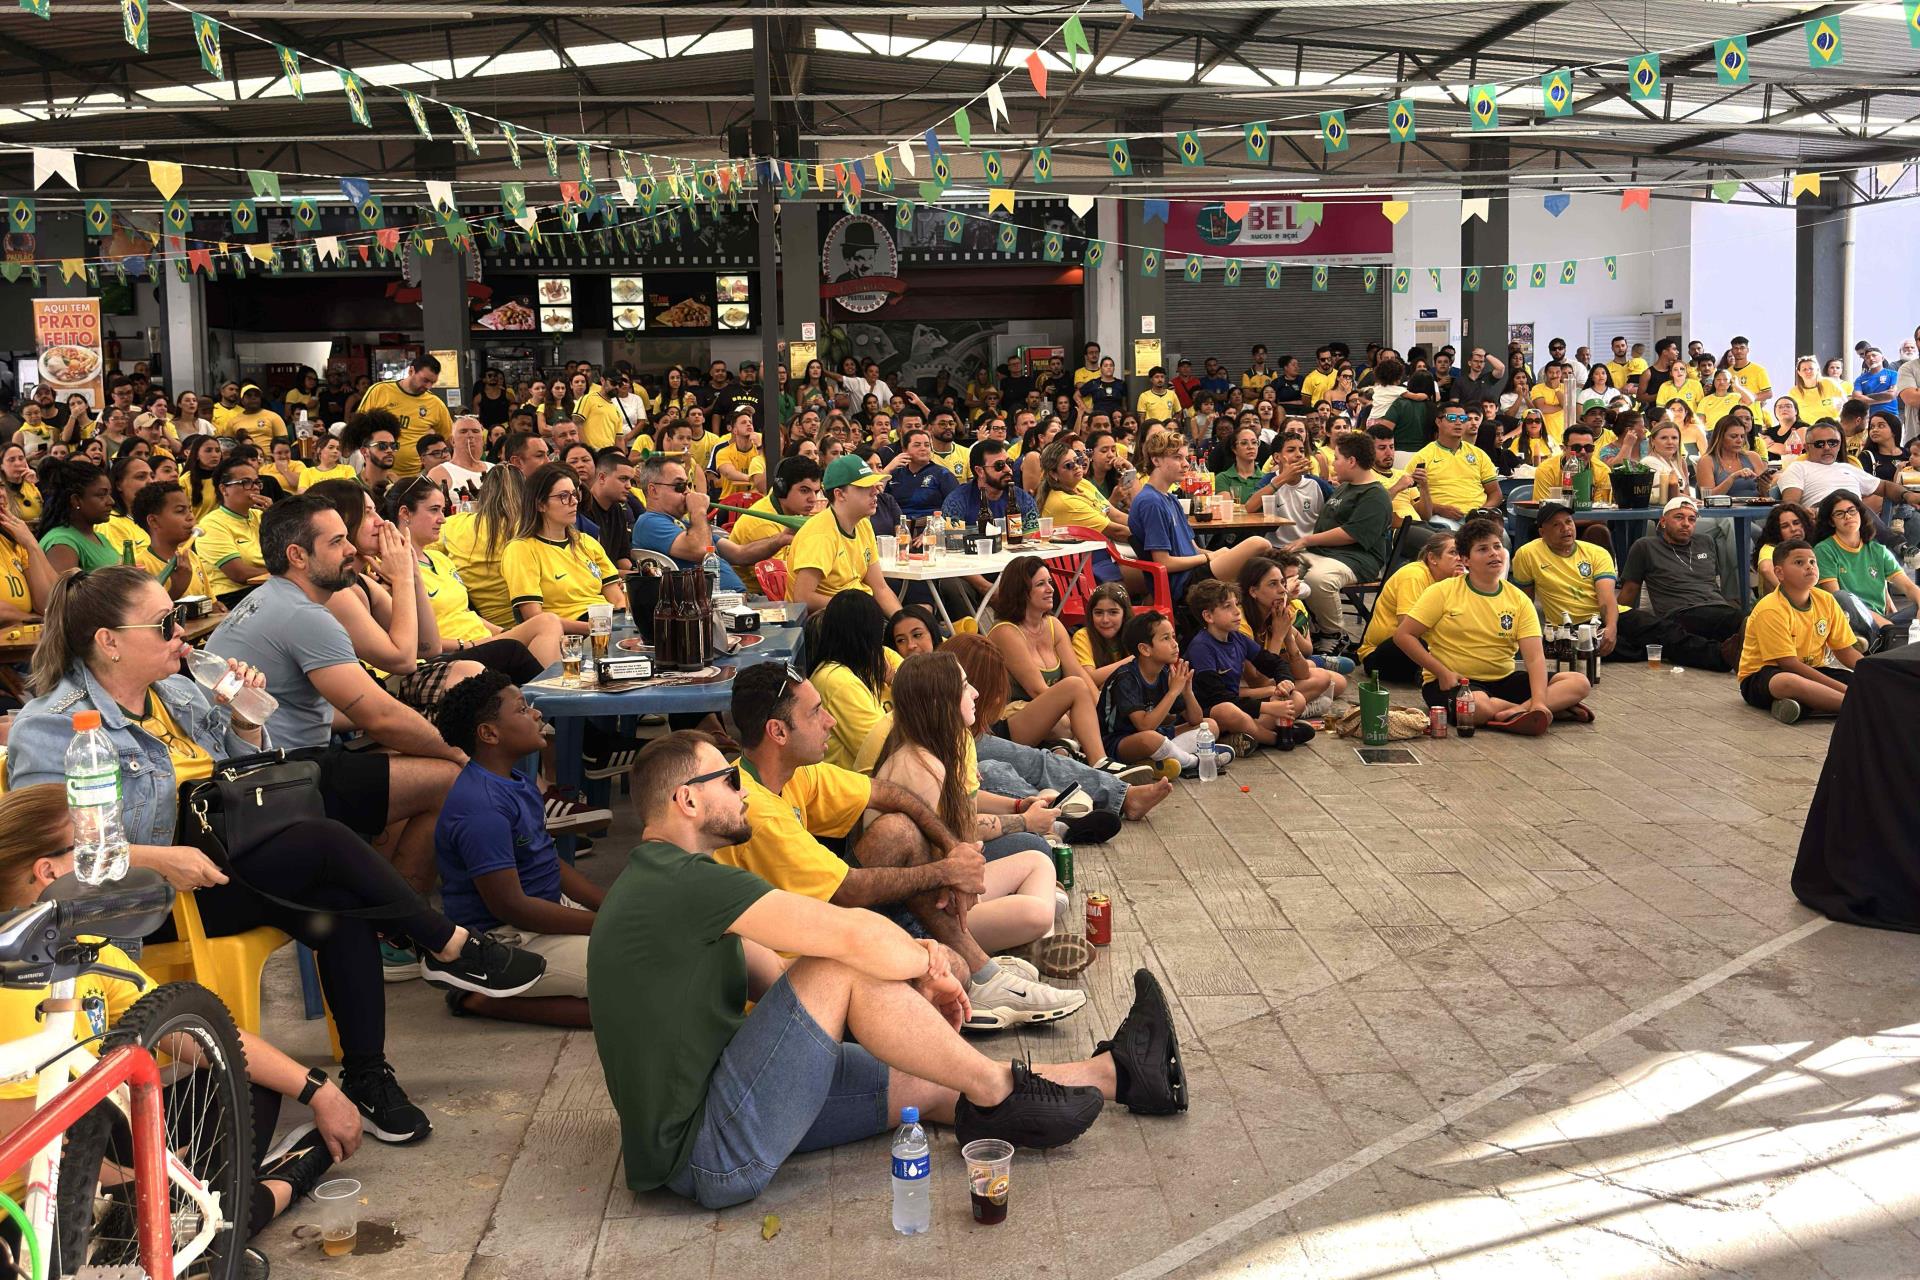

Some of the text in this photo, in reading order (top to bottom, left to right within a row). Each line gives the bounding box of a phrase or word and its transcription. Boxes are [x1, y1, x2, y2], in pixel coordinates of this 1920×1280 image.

[1248, 206, 1302, 230] BEL
[1283, 231, 1298, 241] açaí
[44, 304, 91, 314] AQUI TEM
[38, 314, 96, 329] PRATO
[44, 331, 93, 346] FEITO
[731, 395, 759, 404] BRASIL
[5, 574, 25, 598] 10
